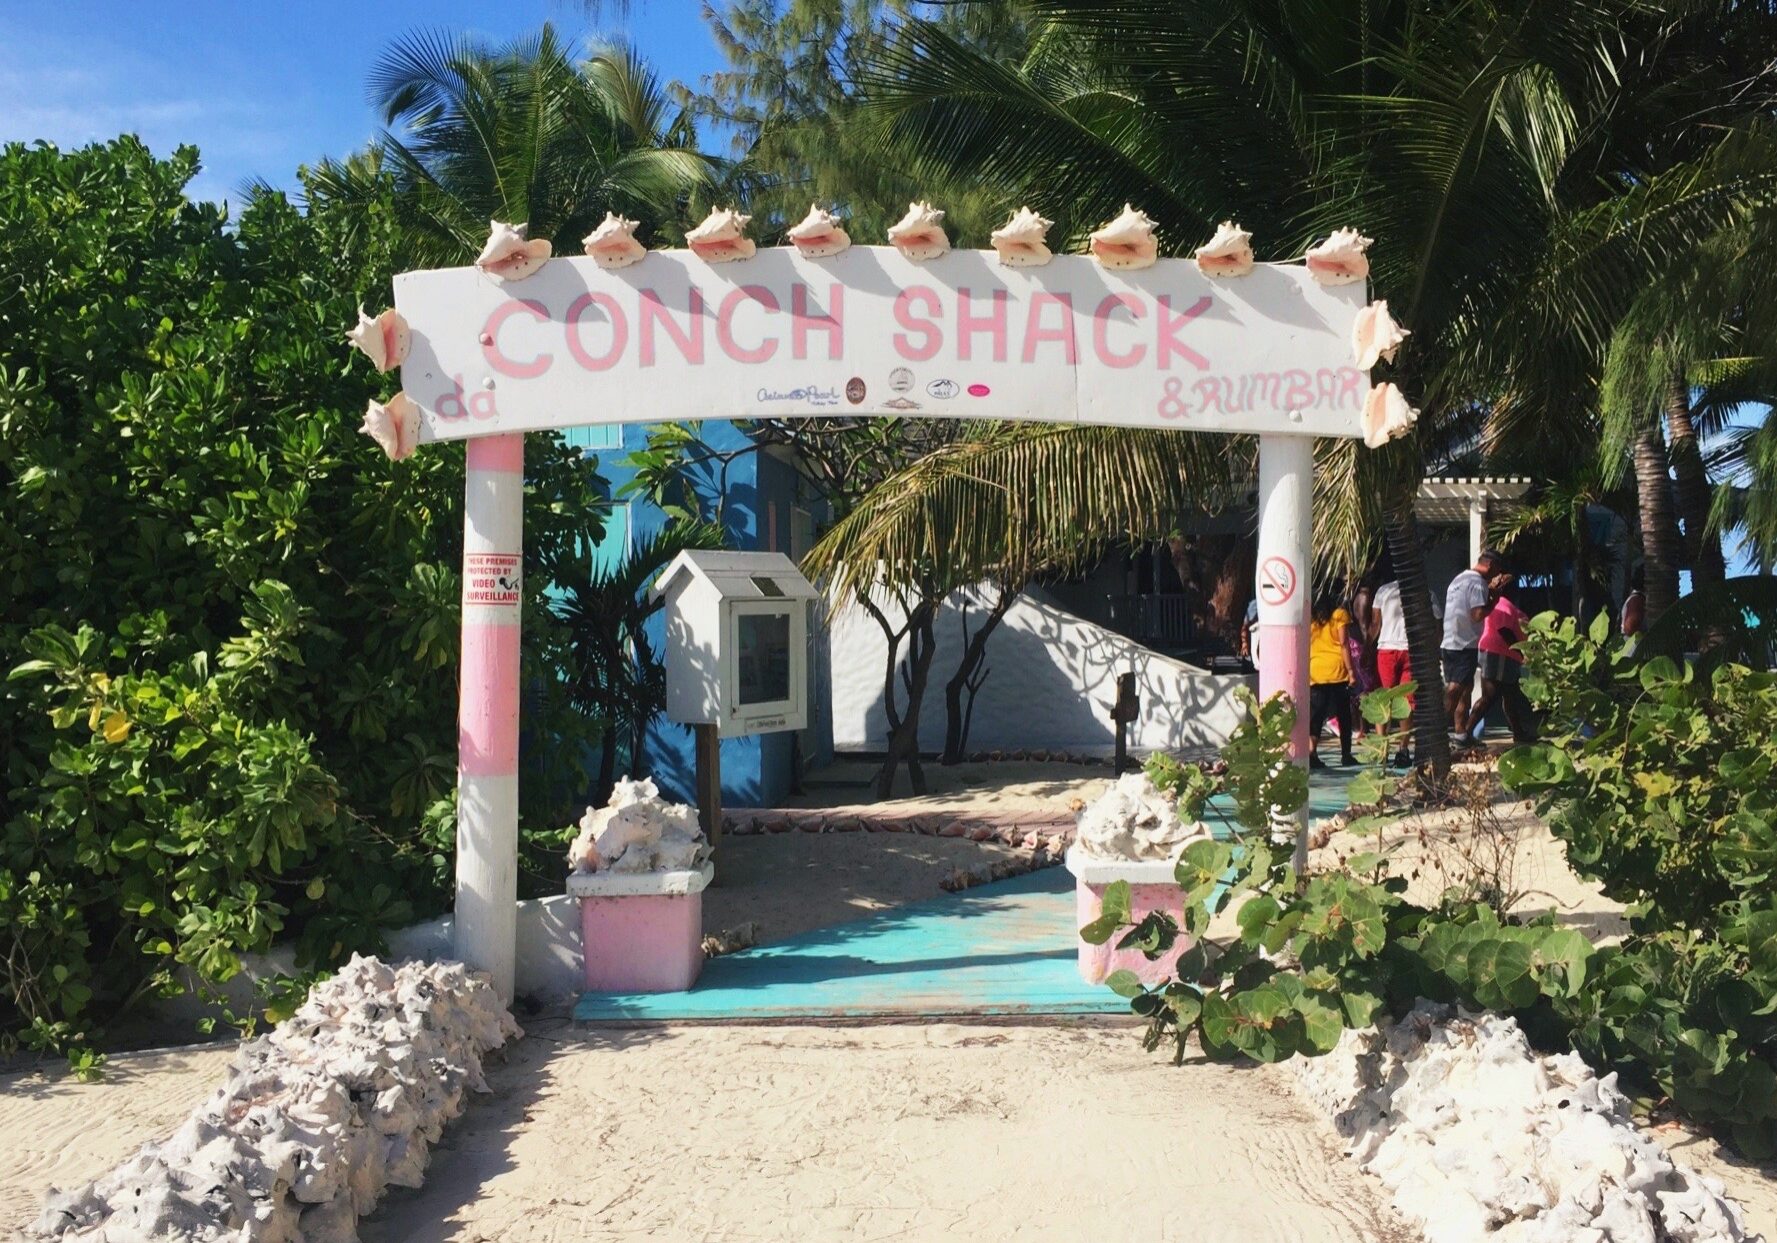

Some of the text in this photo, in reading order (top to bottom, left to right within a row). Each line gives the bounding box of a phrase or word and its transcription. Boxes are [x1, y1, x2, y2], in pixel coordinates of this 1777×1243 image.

[481, 282, 1214, 380] CONCH SHACK
[434, 373, 497, 425] da
[467, 567, 502, 575] PROTECTED
[472, 579, 495, 588] VIDEO
[467, 592, 519, 601] SURVEILLANCE
